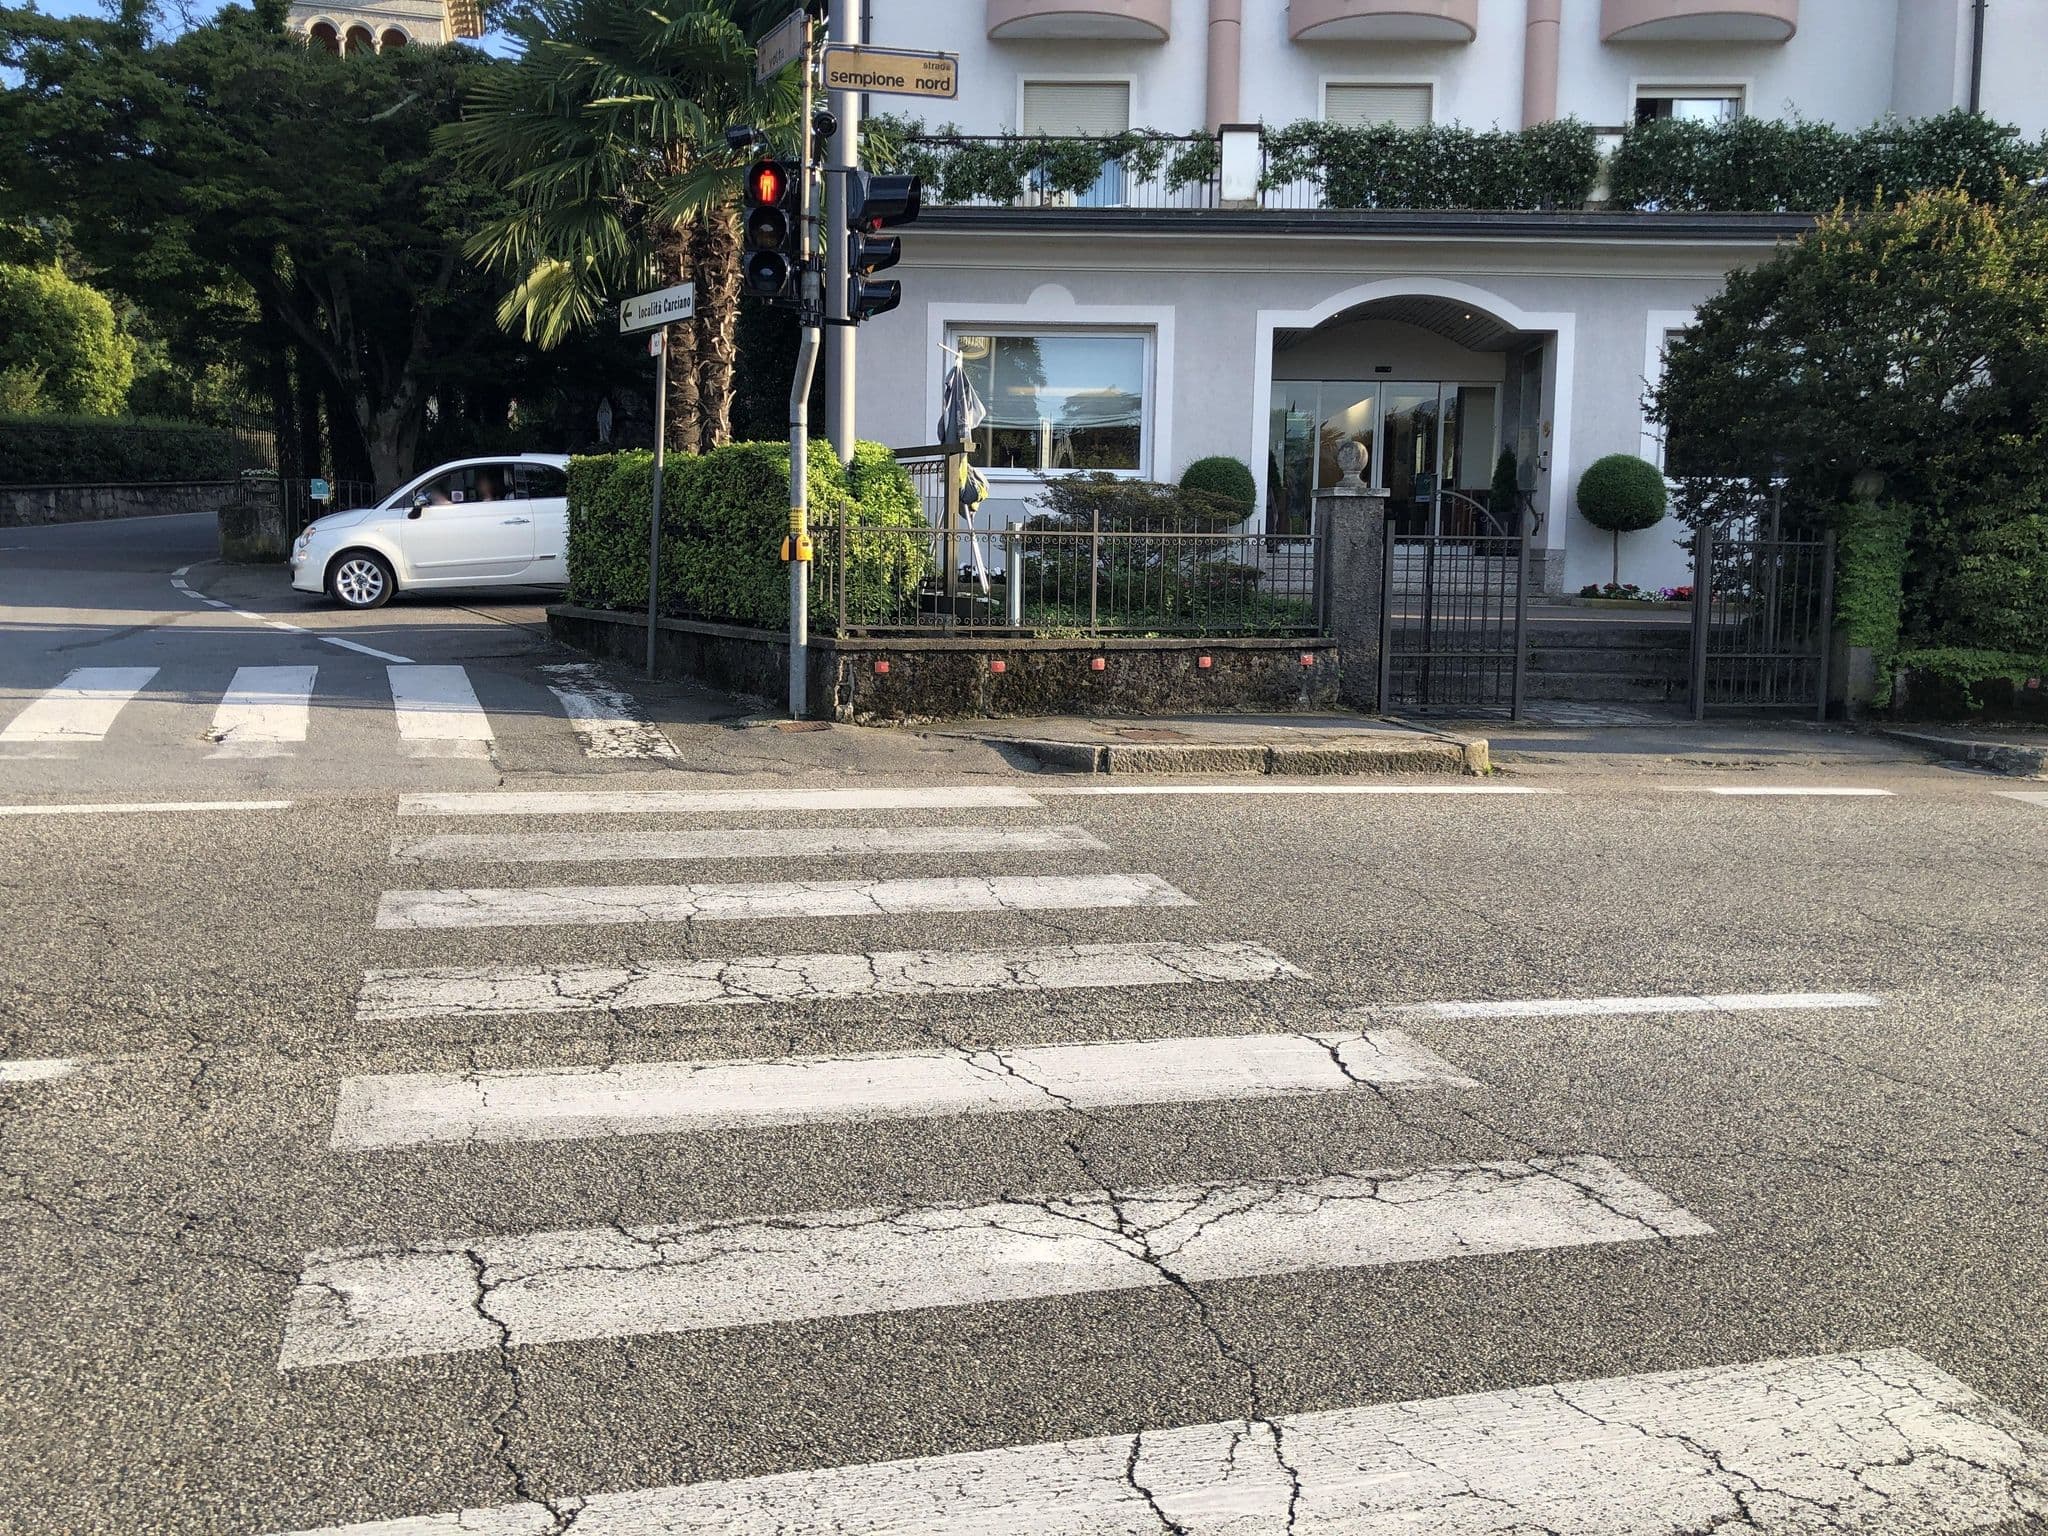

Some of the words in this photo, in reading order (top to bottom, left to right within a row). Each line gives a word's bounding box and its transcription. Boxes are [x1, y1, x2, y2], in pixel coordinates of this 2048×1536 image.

[923, 61, 951, 71] strada
[831, 69, 905, 88] sempione
[915, 77, 950, 91] nord
[638, 301, 661, 319] località
[664, 296, 691, 312] Carciano
